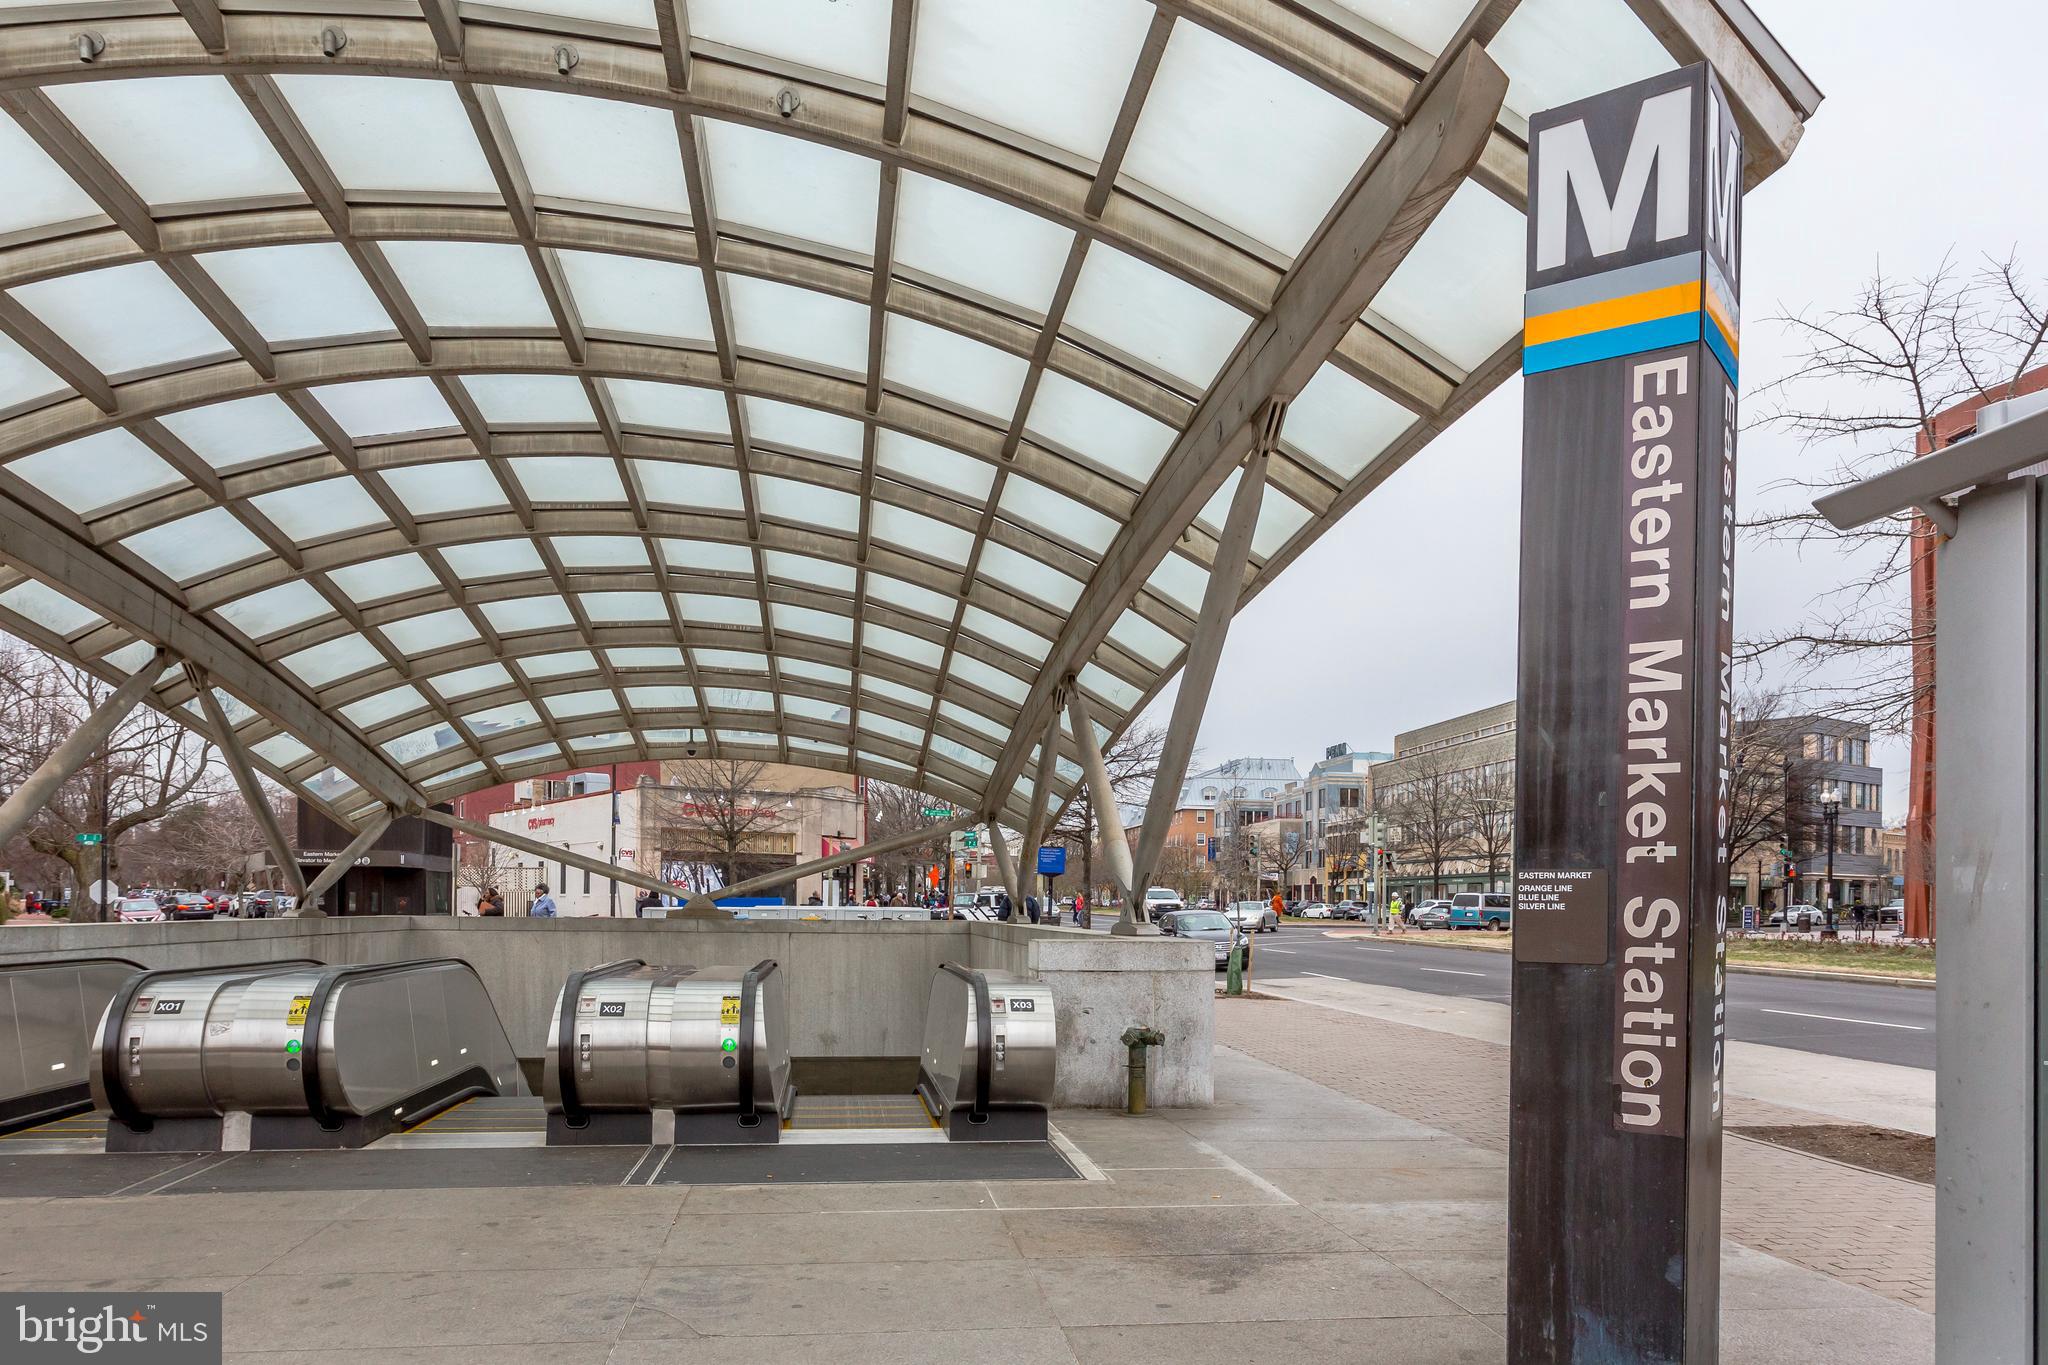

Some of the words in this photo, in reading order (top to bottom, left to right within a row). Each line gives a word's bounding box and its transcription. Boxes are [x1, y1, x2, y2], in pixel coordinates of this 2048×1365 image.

[1536, 86, 1692, 272] M
[1708, 86, 1736, 282] M
[1629, 356, 1688, 609] Eastern
[1721, 383, 1735, 622] Eastern
[1625, 639, 1683, 864] Market
[1717, 652, 1731, 864] Market
[1518, 871, 1556, 880] EASTERN
[1557, 871, 1593, 880] MARKET
[1518, 884, 1553, 893] ORANGE
[1554, 884, 1573, 893] LINE
[1518, 893, 1540, 902] BLUE
[1541, 893, 1560, 902] LINE
[1518, 902, 1546, 911] SILVER
[1547, 902, 1566, 911] LINE
[602, 1005, 623, 1013] X02
[1012, 1001, 1033, 1009] X03
[1620, 896, 1681, 1127] Station
[1711, 895, 1727, 1113] Station
